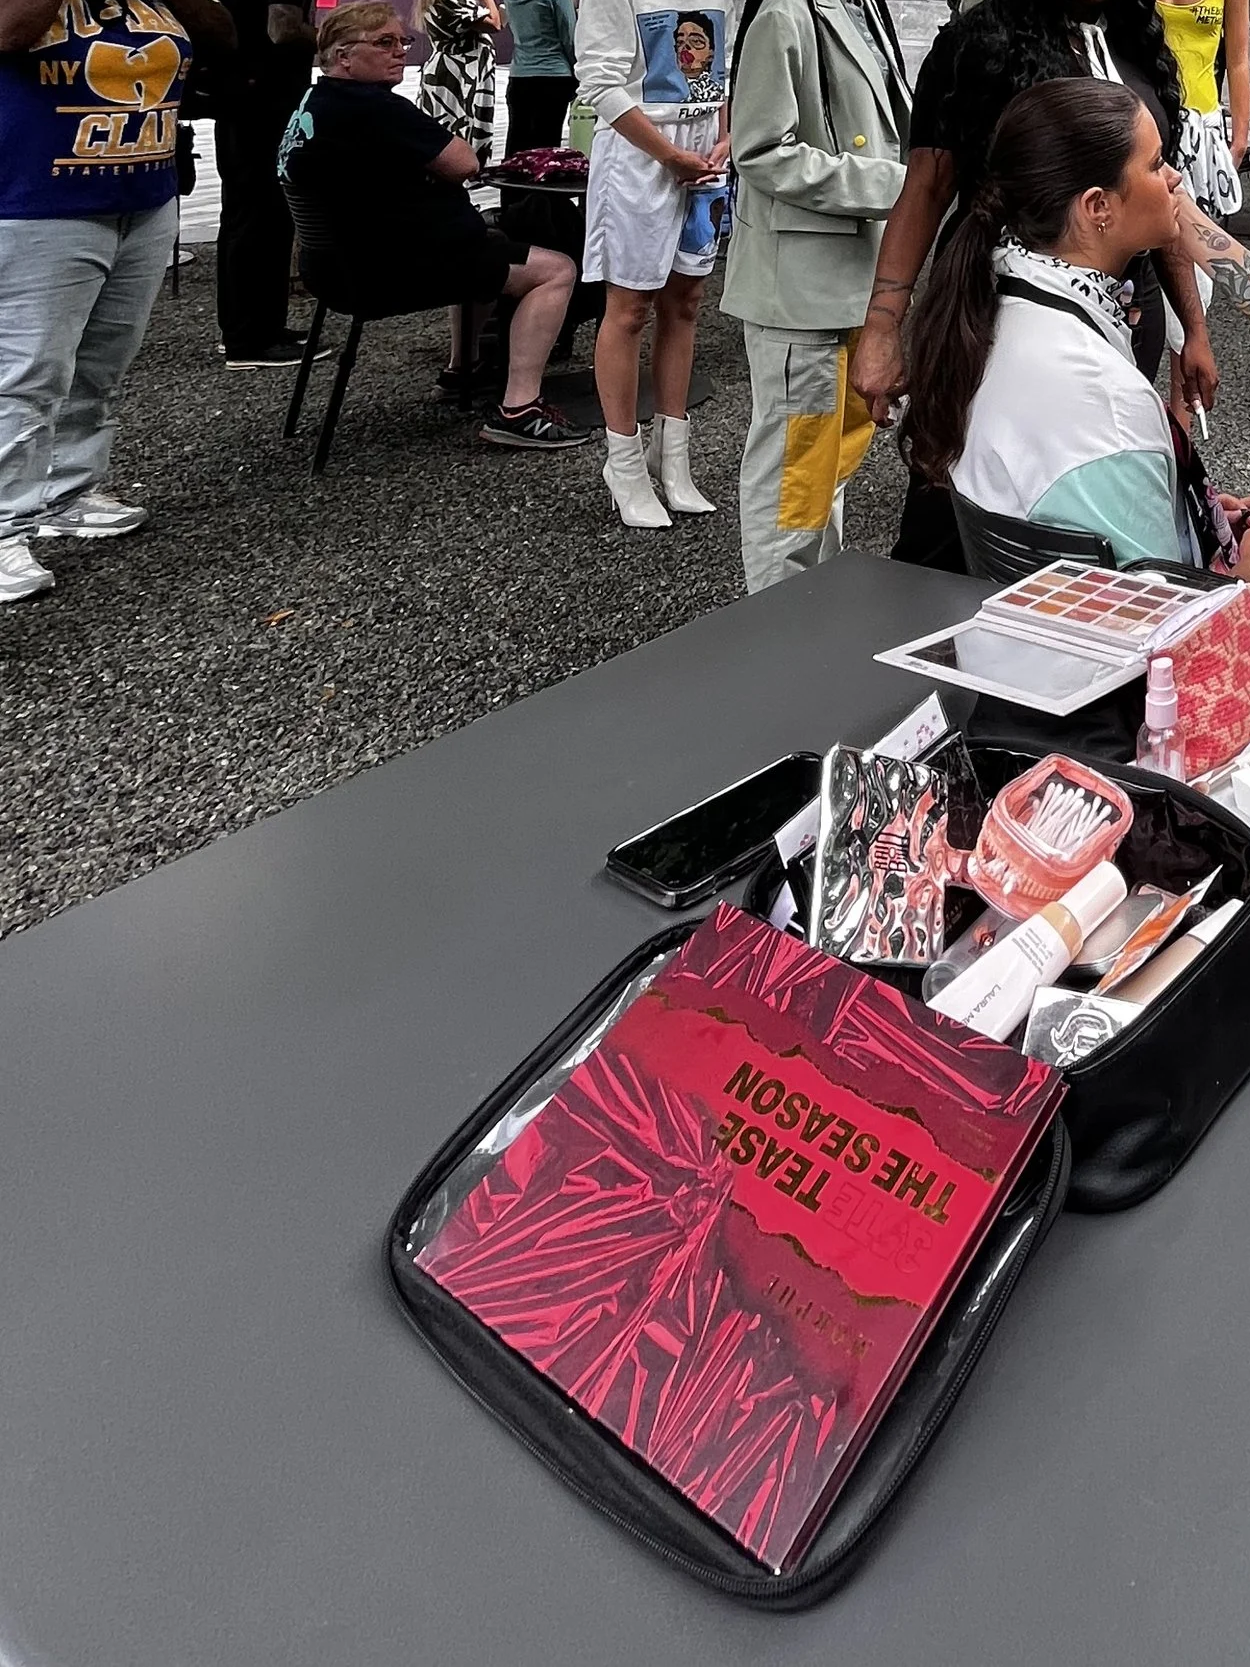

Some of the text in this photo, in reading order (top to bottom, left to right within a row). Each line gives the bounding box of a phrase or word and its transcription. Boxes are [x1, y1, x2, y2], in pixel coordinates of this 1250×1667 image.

[39, 60, 81, 85] NY
[716, 1110, 832, 1214] TEASE
[723, 1061, 958, 1225] THE SEASON
